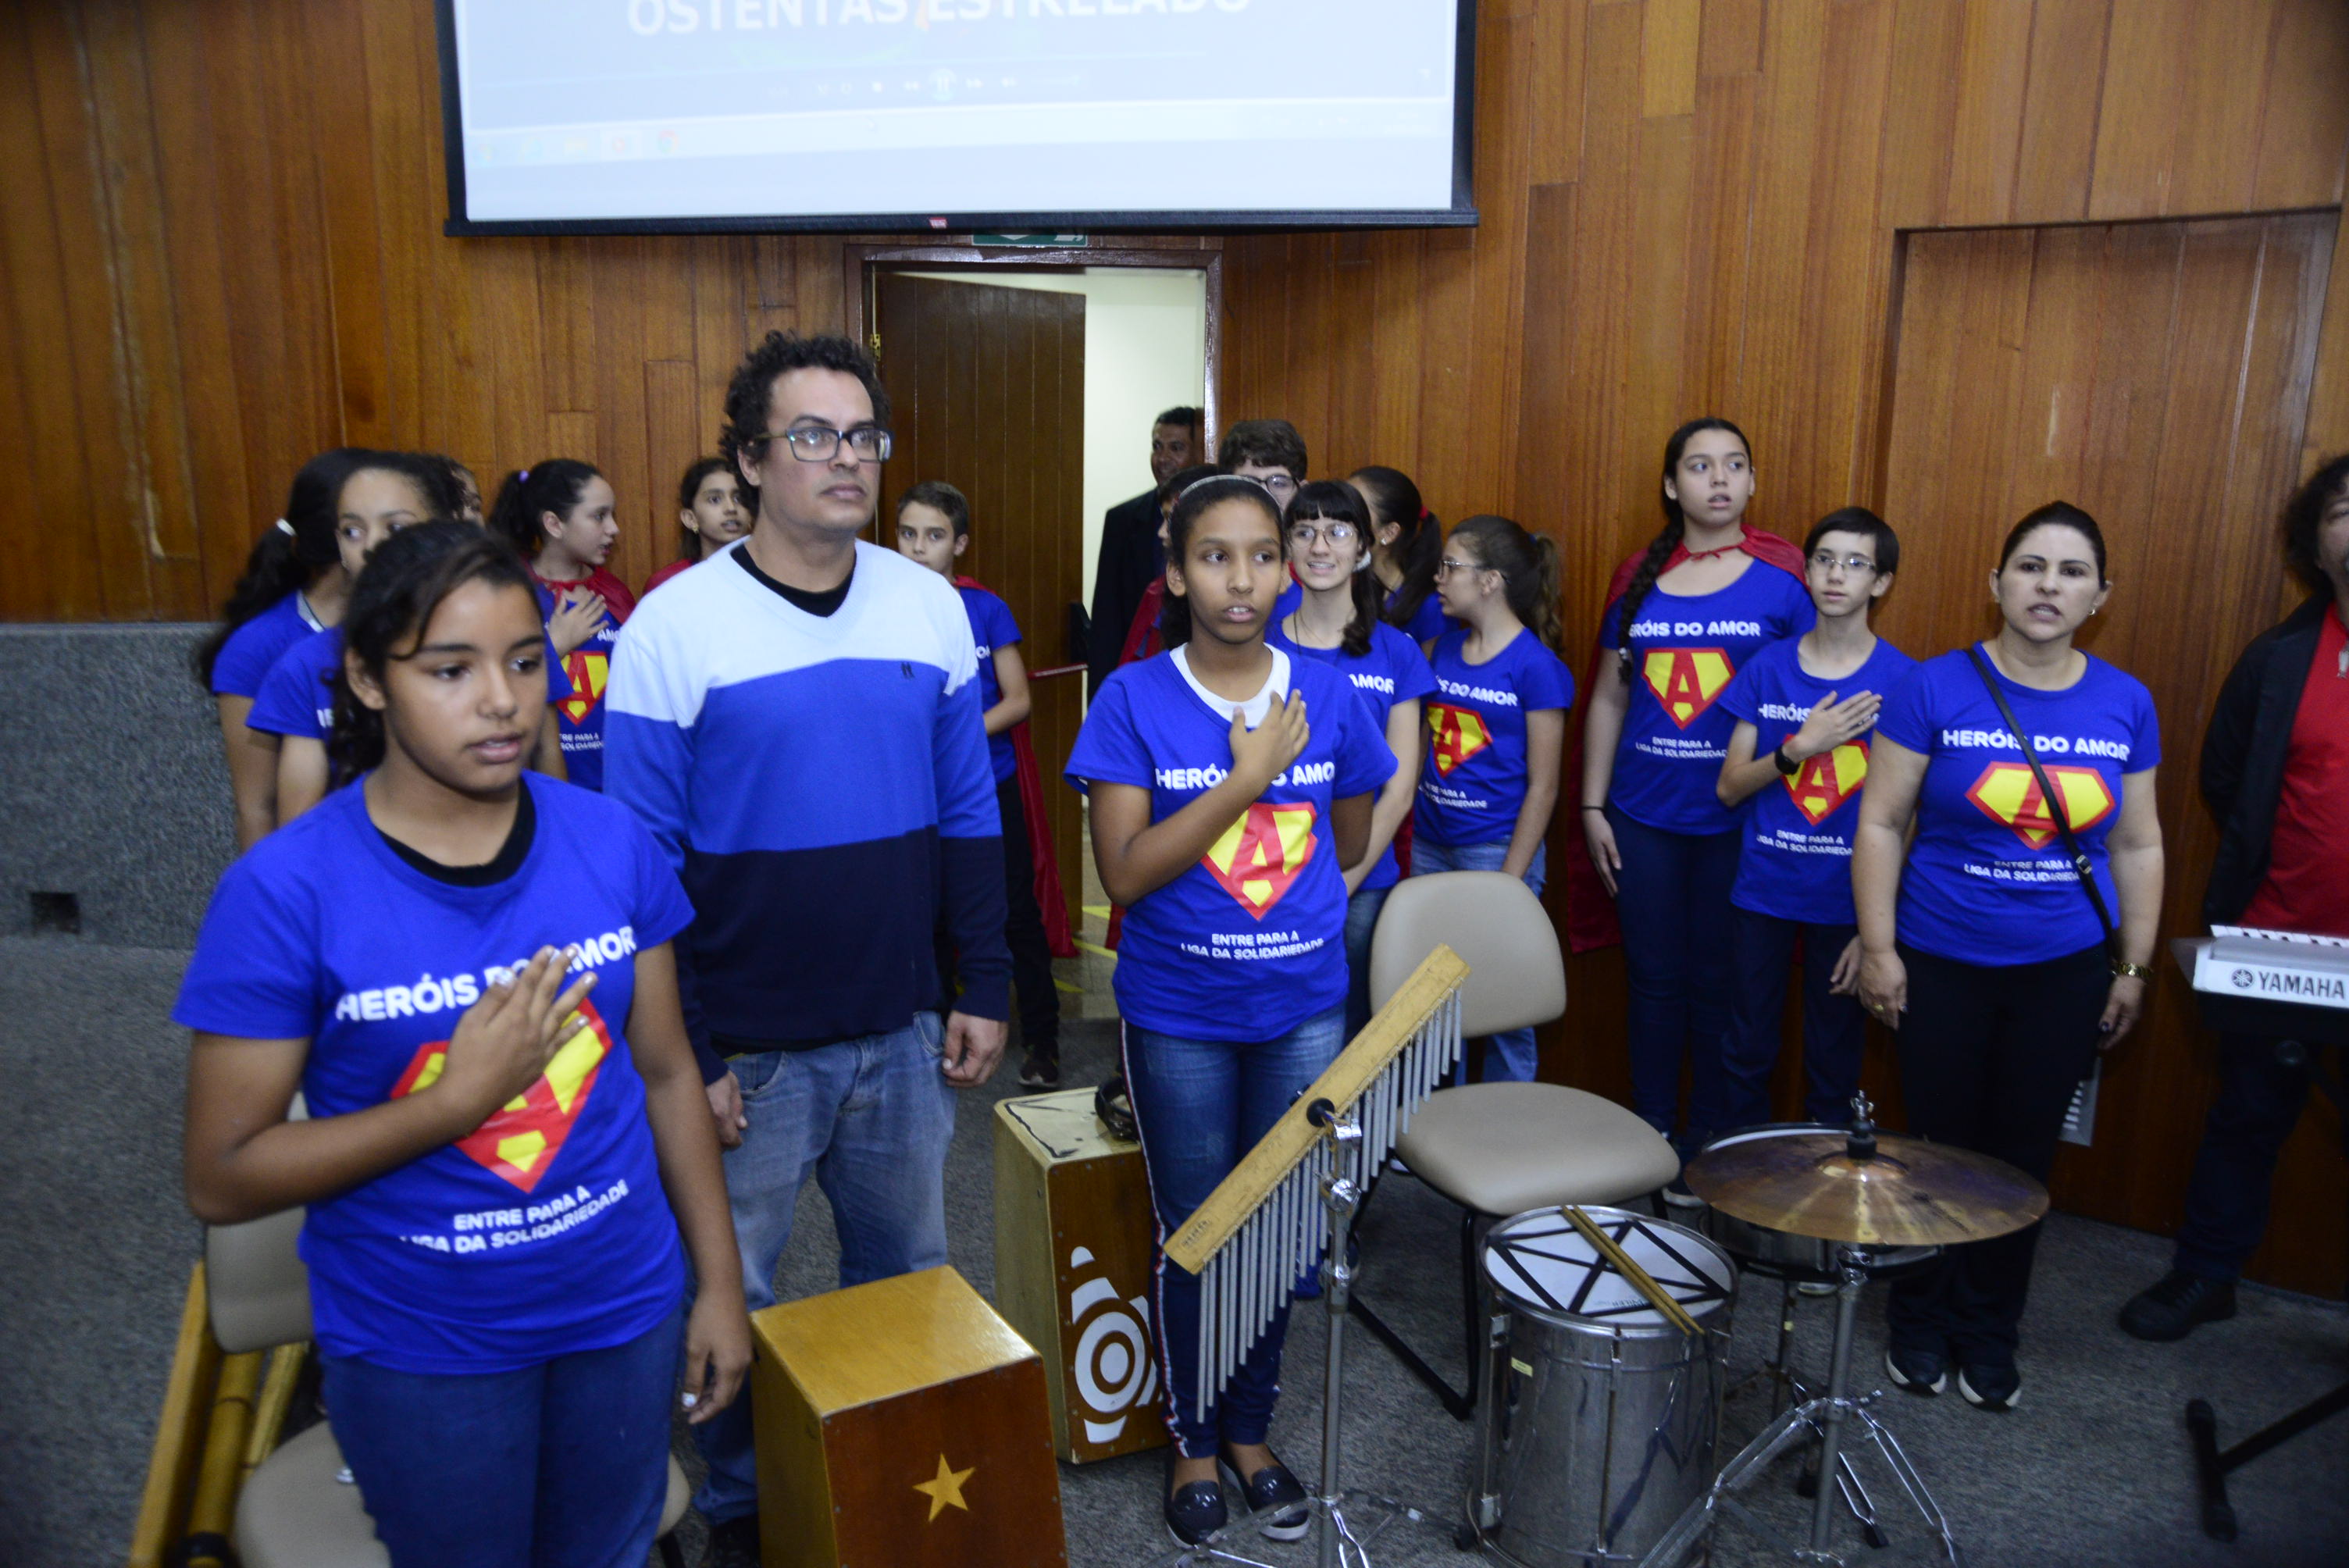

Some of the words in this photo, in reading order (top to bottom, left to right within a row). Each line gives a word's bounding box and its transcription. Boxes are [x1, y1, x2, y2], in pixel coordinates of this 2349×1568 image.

[1674, 622, 1704, 636] DO
[1706, 620, 1761, 637] AMOR
[1448, 682, 1470, 697] DO
[1469, 686, 1518, 707] AMOR
[1652, 736, 1677, 748] ENTRE
[1678, 739, 1702, 749] PARA
[1704, 740, 1711, 749] A
[2034, 735, 2069, 753] DO
[2074, 737, 2130, 761] AMOR
[1292, 761, 1335, 786] AMO
[1777, 829, 1806, 843] ENTRE
[1808, 836, 1834, 844] PARA
[1964, 863, 1991, 877] LIGA
[1993, 868, 2012, 880] DA
[2035, 860, 2065, 870] PARA
[1180, 943, 1210, 957] LIGA
[1211, 947, 1232, 960] DA
[1233, 938, 1324, 960] SOLIDARIEDADE
[1211, 933, 1255, 946] ENTRE
[1256, 931, 1289, 946] PARA
[1290, 930, 1299, 942] A
[336, 973, 479, 1021] HERÓIS
[2258, 971, 2345, 1000] YAMAHA
[454, 1208, 524, 1231] ENTRE
[526, 1193, 577, 1224] PARA
[576, 1185, 592, 1203] A
[454, 1235, 487, 1254] DA
[490, 1178, 630, 1249] SOLIDARIEDADE
